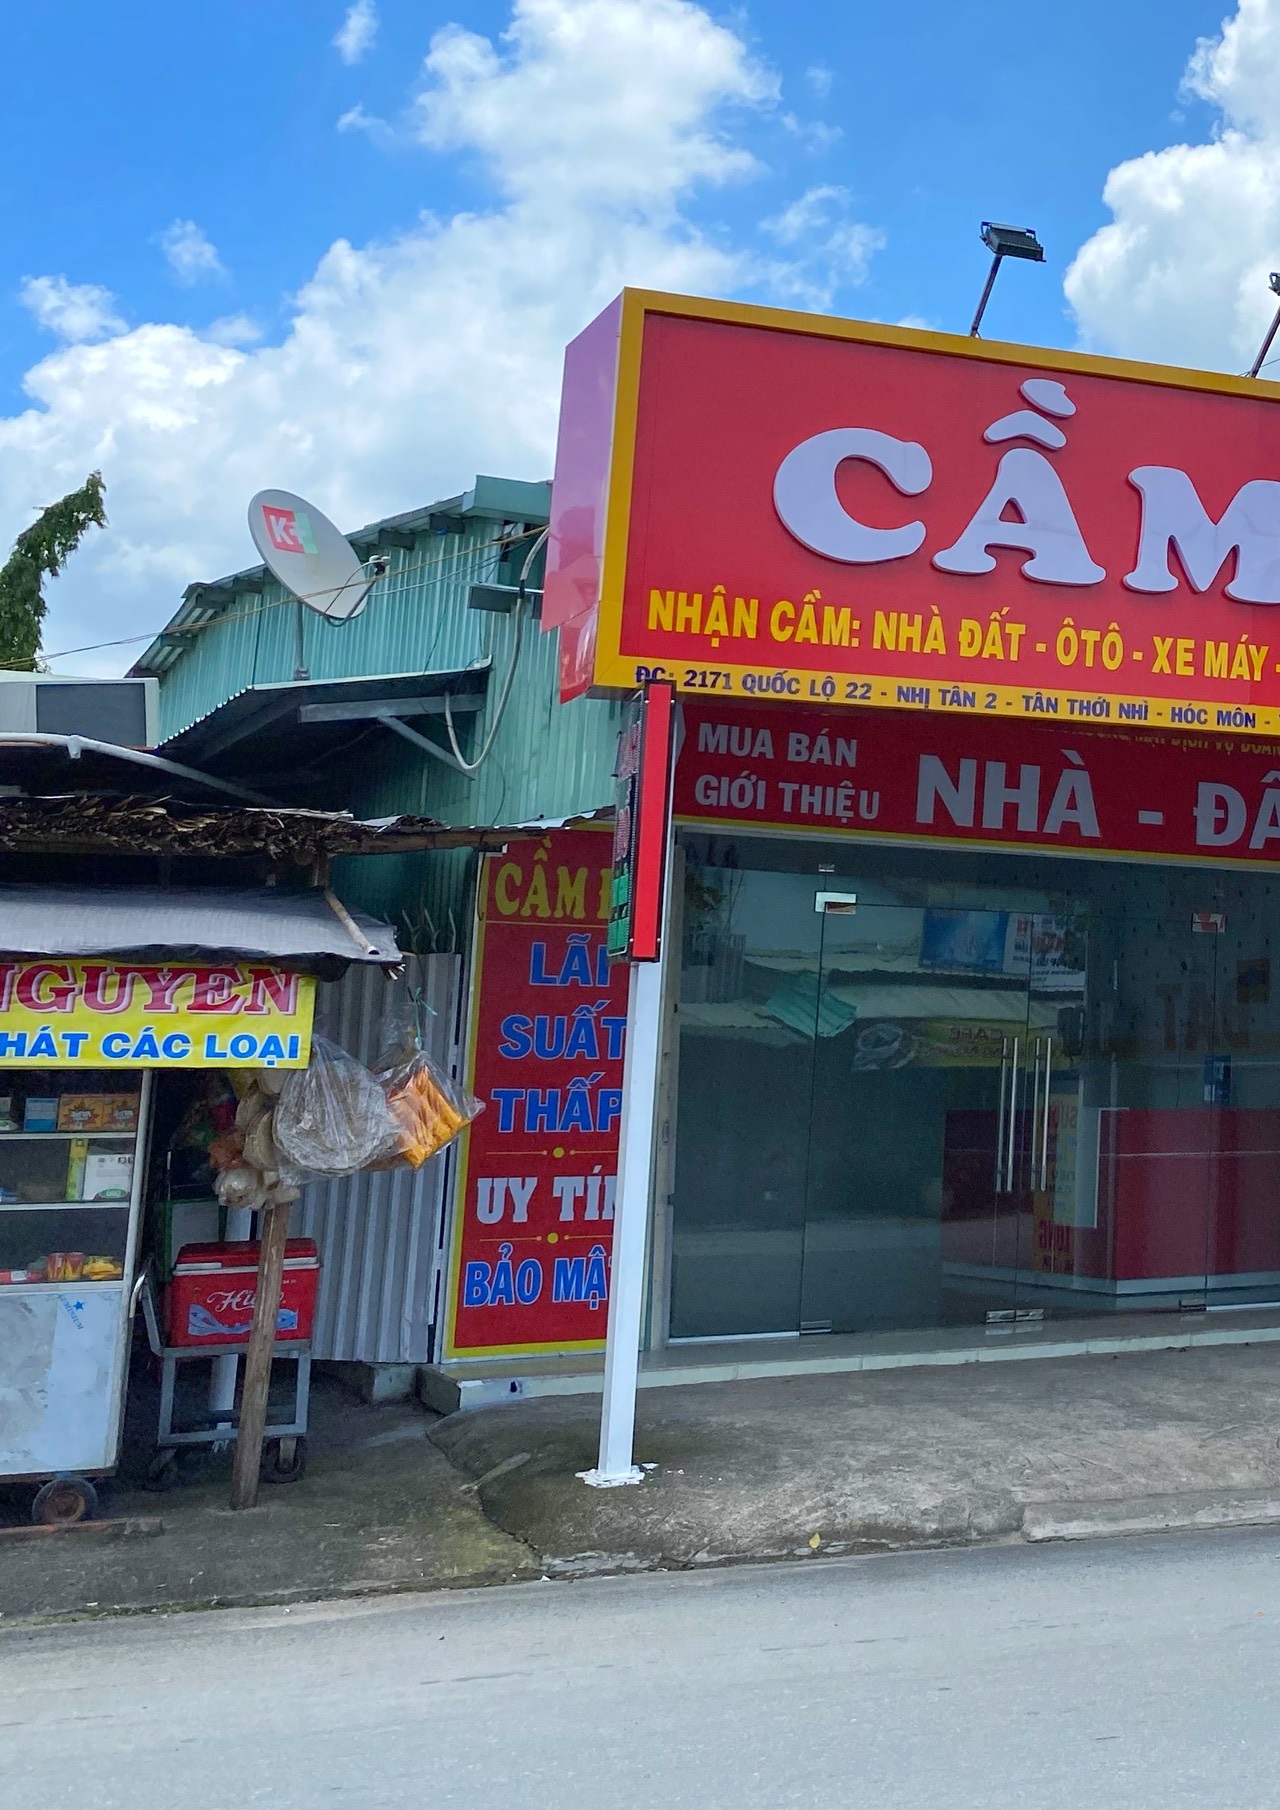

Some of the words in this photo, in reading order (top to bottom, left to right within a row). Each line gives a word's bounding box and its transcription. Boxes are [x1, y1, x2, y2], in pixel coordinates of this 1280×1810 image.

[648, 585, 758, 647] NHẬN
[770, 590, 860, 647] CẦM:
[873, 605, 946, 655] NHÀ
[959, 607, 1026, 661] ĐẤT
[1056, 617, 1124, 671] ÔTÔ
[1152, 636, 1195, 676] XE
[1204, 634, 1269, 681] MÁY
[683, 669, 732, 690] 2171
[742, 670, 800, 695] QUỐC
[810, 675, 835, 701] LỘ
[845, 682, 872, 700] 22
[897, 685, 930, 709] NHỊ
[939, 686, 975, 709] TÂN
[984, 693, 996, 709] 2
[1022, 692, 1058, 714] TÂN
[1067, 696, 1110, 719] THỚI
[1170, 703, 1208, 724] HÓC
[1217, 707, 1256, 729] MÔN
[698, 723, 774, 759] MUA
[787, 729, 858, 768] BÁN
[695, 770, 766, 810] GIỚI
[778, 781, 879, 823] THIỆU
[916, 749, 1100, 837] NHÀ
[495, 835, 588, 919] CẦM
[102, 1026, 191, 1060] CÁC
[205, 1034, 300, 1066] LOẠI
[498, 1000, 628, 1060] SUẤT
[491, 1072, 623, 1132] THẤP
[476, 1176, 538, 1224] UY
[464, 1243, 543, 1307] BẢO
[553, 1244, 612, 1310] MẬ
